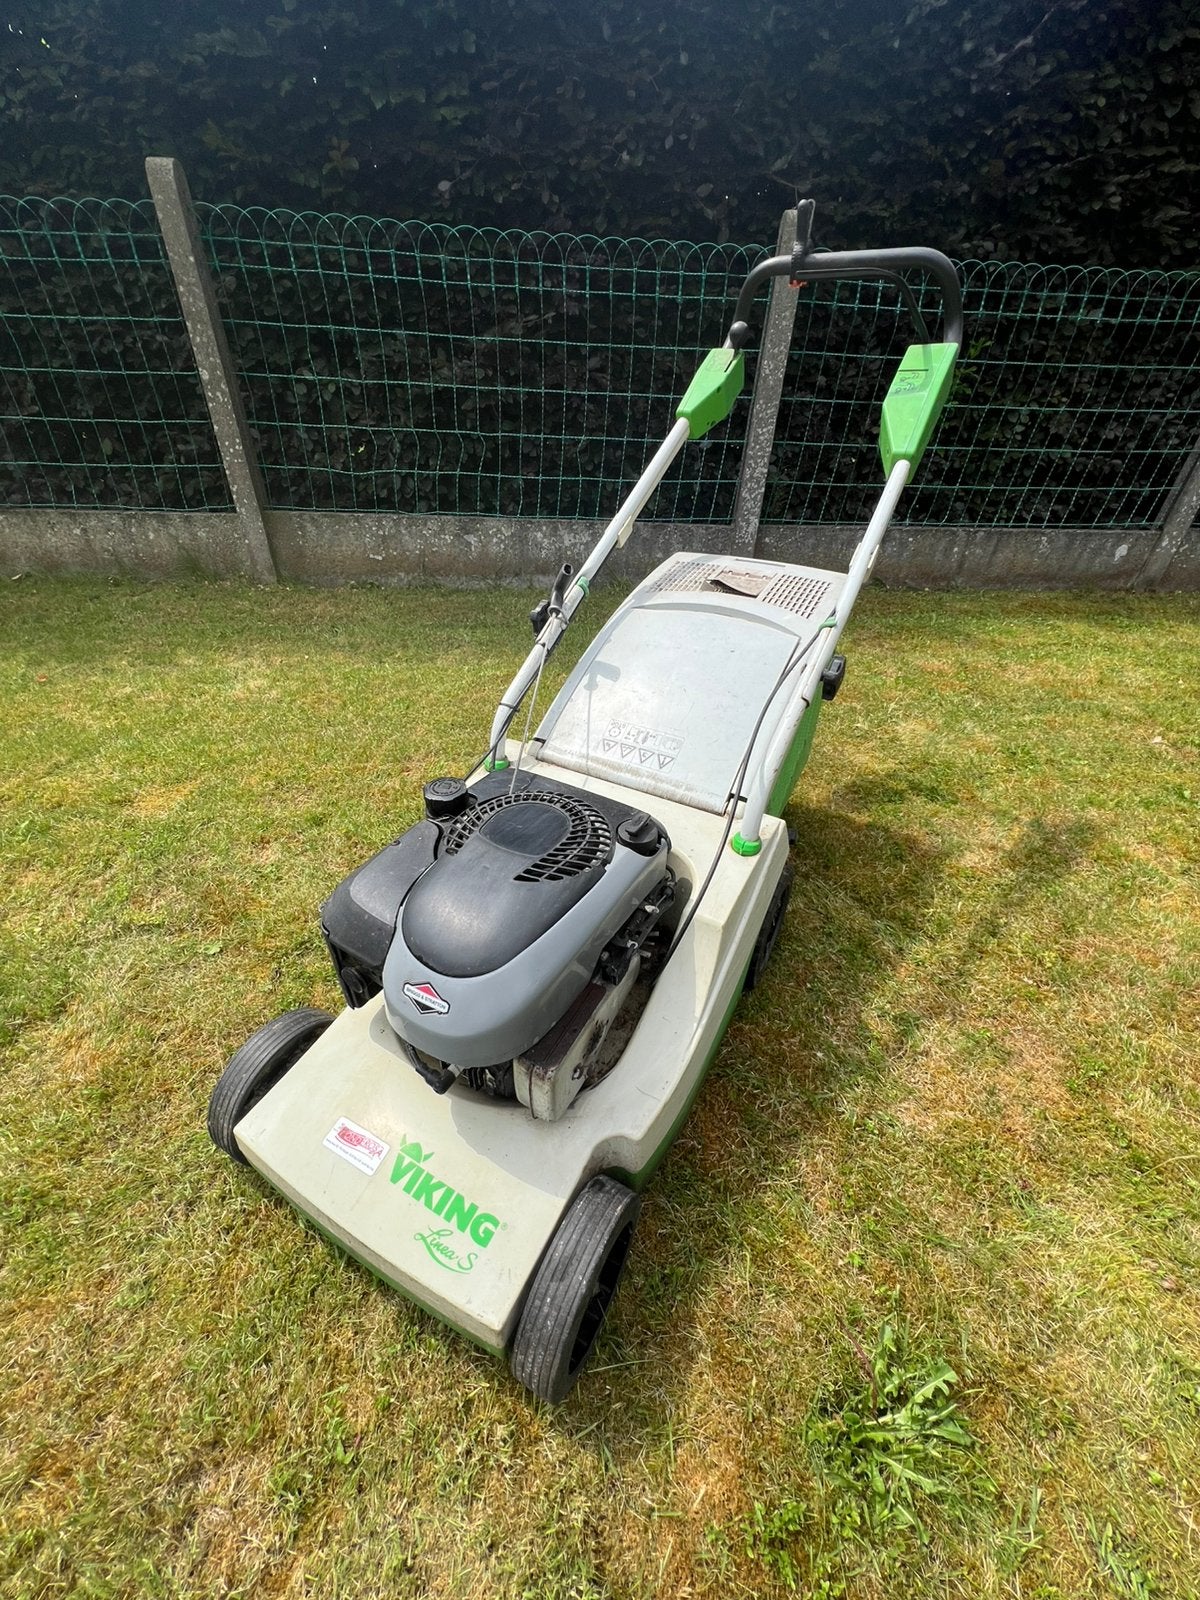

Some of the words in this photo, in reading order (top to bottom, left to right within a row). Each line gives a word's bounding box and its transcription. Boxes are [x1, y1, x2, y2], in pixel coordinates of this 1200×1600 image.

[389, 1152, 501, 1249] VIKING
[414, 1225, 463, 1268] Linea
[457, 1252, 479, 1271] S
